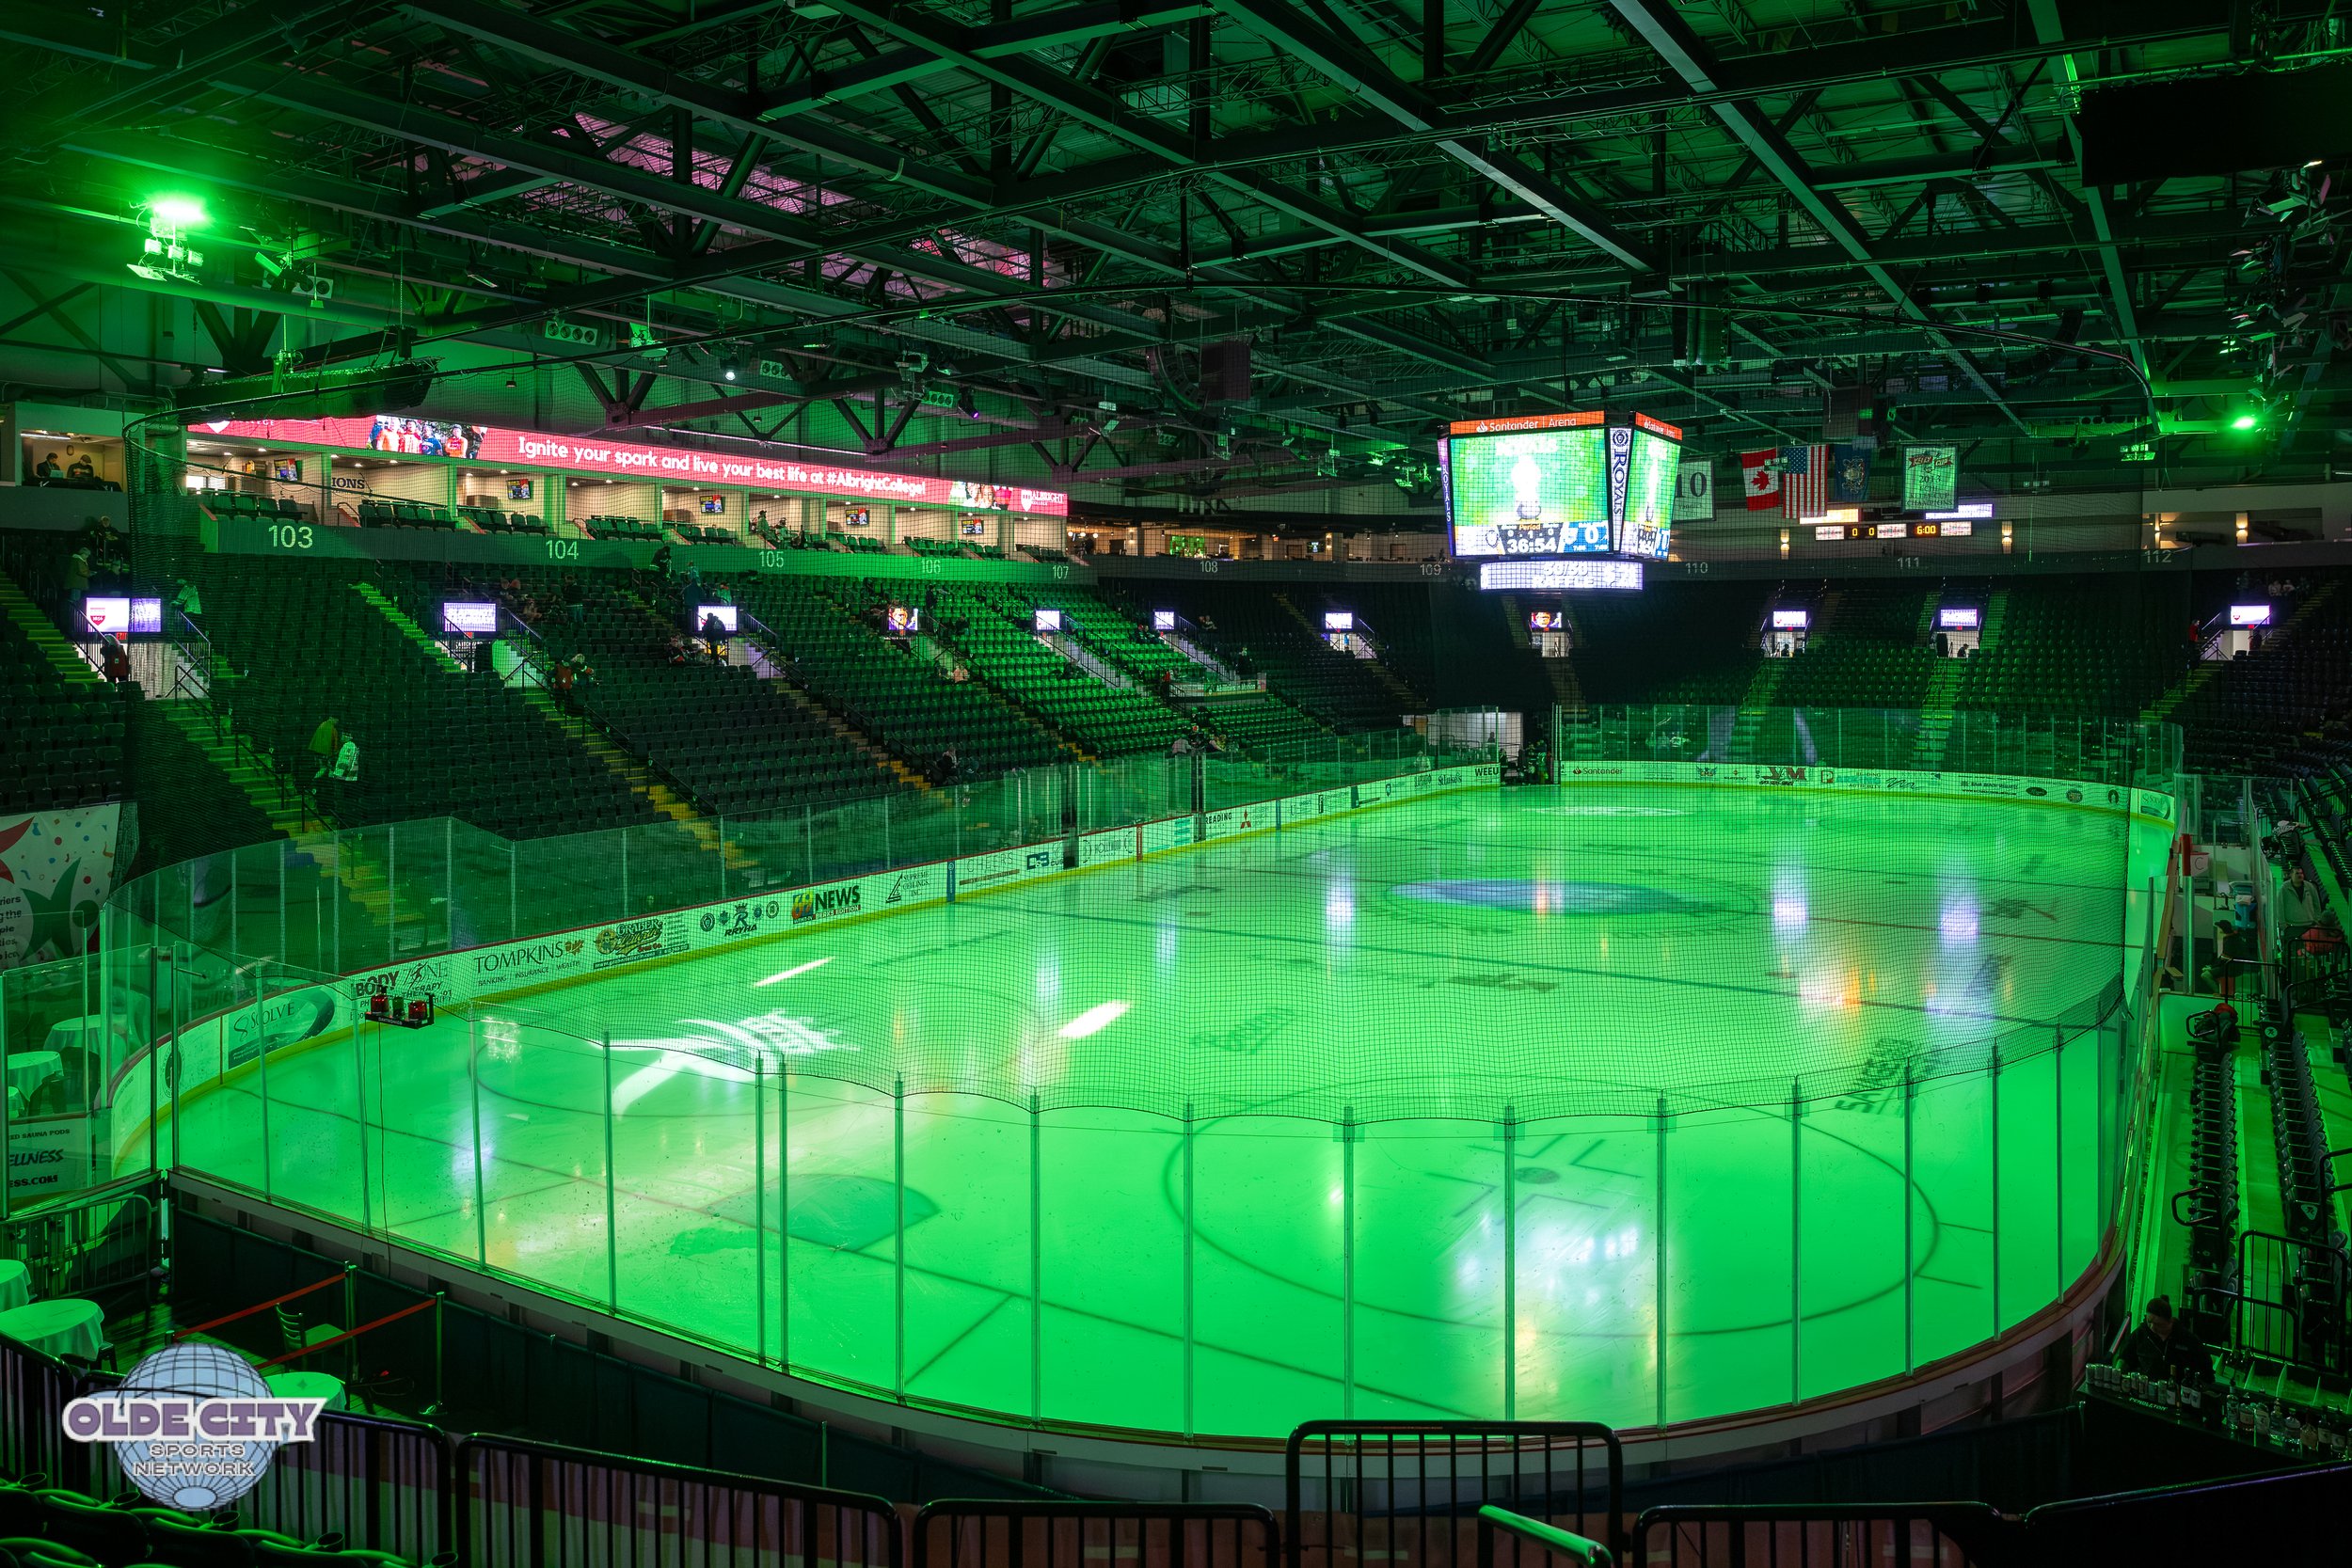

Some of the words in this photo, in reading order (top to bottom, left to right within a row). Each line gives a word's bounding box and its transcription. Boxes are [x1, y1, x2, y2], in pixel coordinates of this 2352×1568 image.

[1489, 420, 1538, 432] Santander
[1548, 418, 1577, 428] Arena
[518, 436, 569, 459] Ignite
[573, 447, 612, 464] your
[614, 450, 658, 468] spark
[661, 454, 690, 470] and
[692, 455, 719, 473] live
[722, 463, 754, 479] your
[755, 463, 786, 480] best
[787, 466, 808, 483] life
[810, 470, 824, 483] at
[1913, 455, 1931, 466] KELLY
[1613, 449, 1628, 515] ROYALS
[1675, 471, 1708, 498] 10
[1441, 465, 1452, 522] ROYALS
[268, 525, 313, 548] 103
[1584, 524, 1598, 544] 0
[1851, 528, 1858, 537] 0
[1868, 527, 1875, 536] 0
[1916, 525, 1936, 534] 6:00
[545, 540, 579, 560] 104
[1507, 537, 1557, 554] 36:54
[758, 549, 785, 568] 105
[2143, 549, 2172, 563] 112
[921, 559, 941, 574] 106
[1200, 561, 1218, 574] 108
[1420, 563, 1442, 576] 109
[1685, 562, 1708, 575] 110
[1897, 557, 1920, 570] 111
[1052, 565, 1069, 580] 107
[1474, 767, 1499, 777] WEEU
[1582, 767, 1623, 775] Santander
[1205, 812, 1232, 825] READING
[792, 891, 814, 919] 69
[815, 884, 861, 911] NEWS
[6, 910, 23, 920] the
[815, 909, 834, 920] BERKS
[835, 904, 860, 914] EDITION
[616, 918, 662, 938] GRABER
[723, 923, 757, 937] RRYHA
[473, 941, 564, 974] TOMPKINS
[478, 974, 507, 987] BANKING
[515, 967, 549, 979] INSURANCE
[556, 960, 580, 970] WEALTH
[22, 1131, 48, 1139] SAUNA
[2129, 1397, 2169, 1411] PENDLETON
